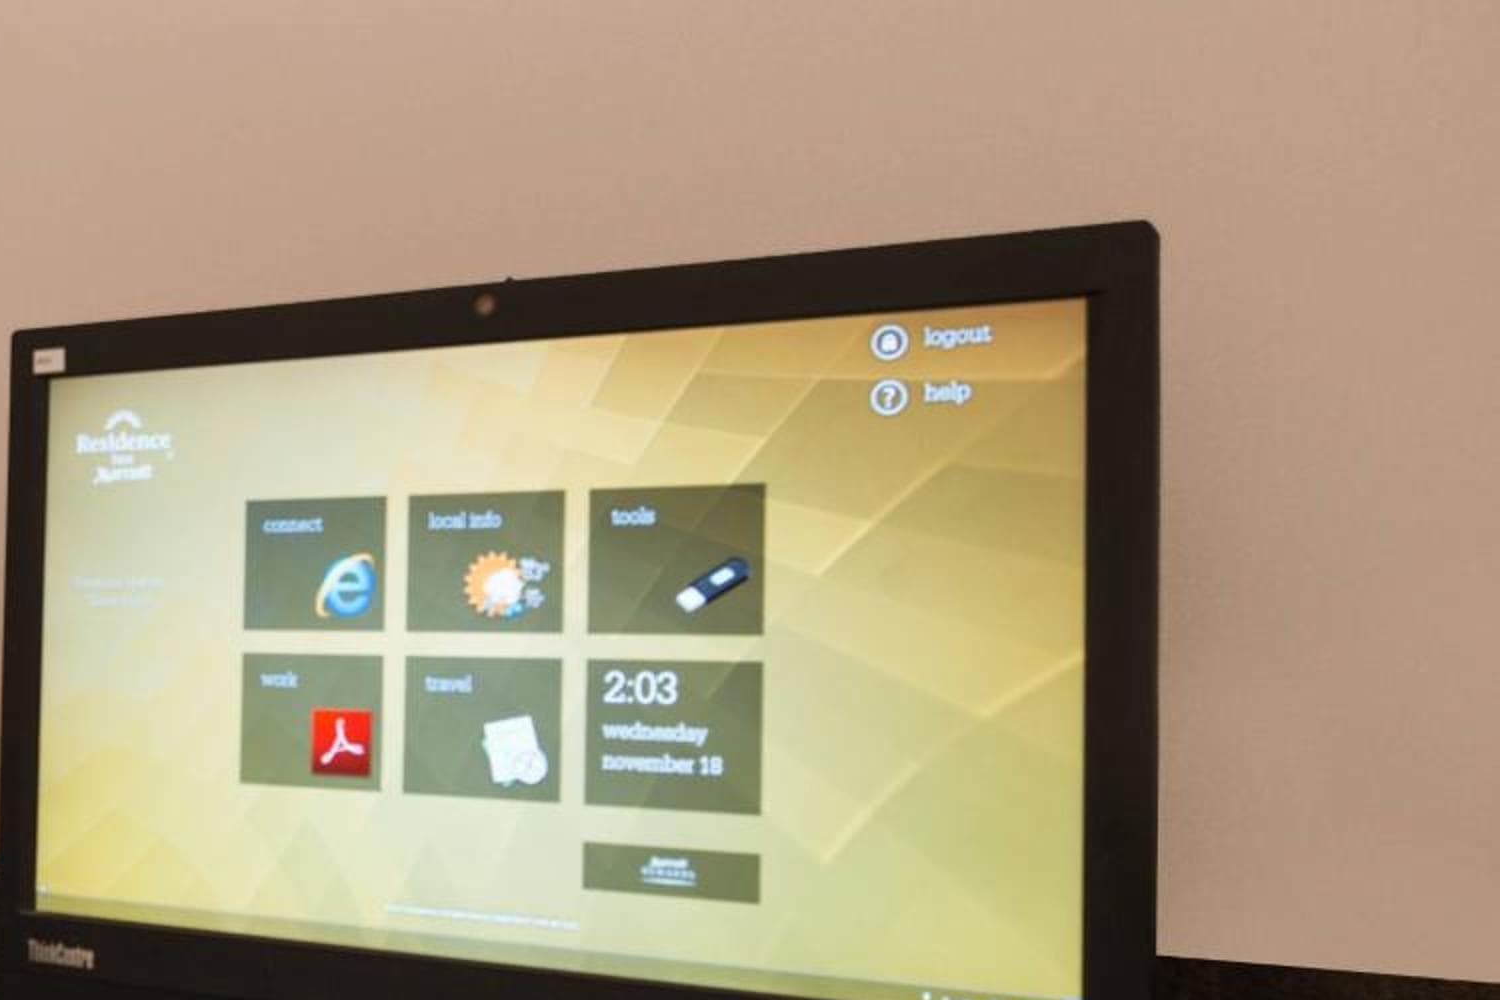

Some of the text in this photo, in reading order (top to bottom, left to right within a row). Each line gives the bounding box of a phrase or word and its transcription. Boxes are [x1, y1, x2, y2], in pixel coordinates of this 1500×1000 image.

[923, 325, 992, 349] logout
[923, 380, 972, 405] help
[75, 432, 172, 453] Residence
[263, 517, 325, 534] connect
[428, 508, 503, 530] local info
[611, 507, 656, 527] tools
[260, 671, 299, 689] work
[425, 674, 473, 694] travel
[603, 670, 678, 704] 2:03
[602, 721, 709, 748] wednesday
[602, 753, 695, 775] november
